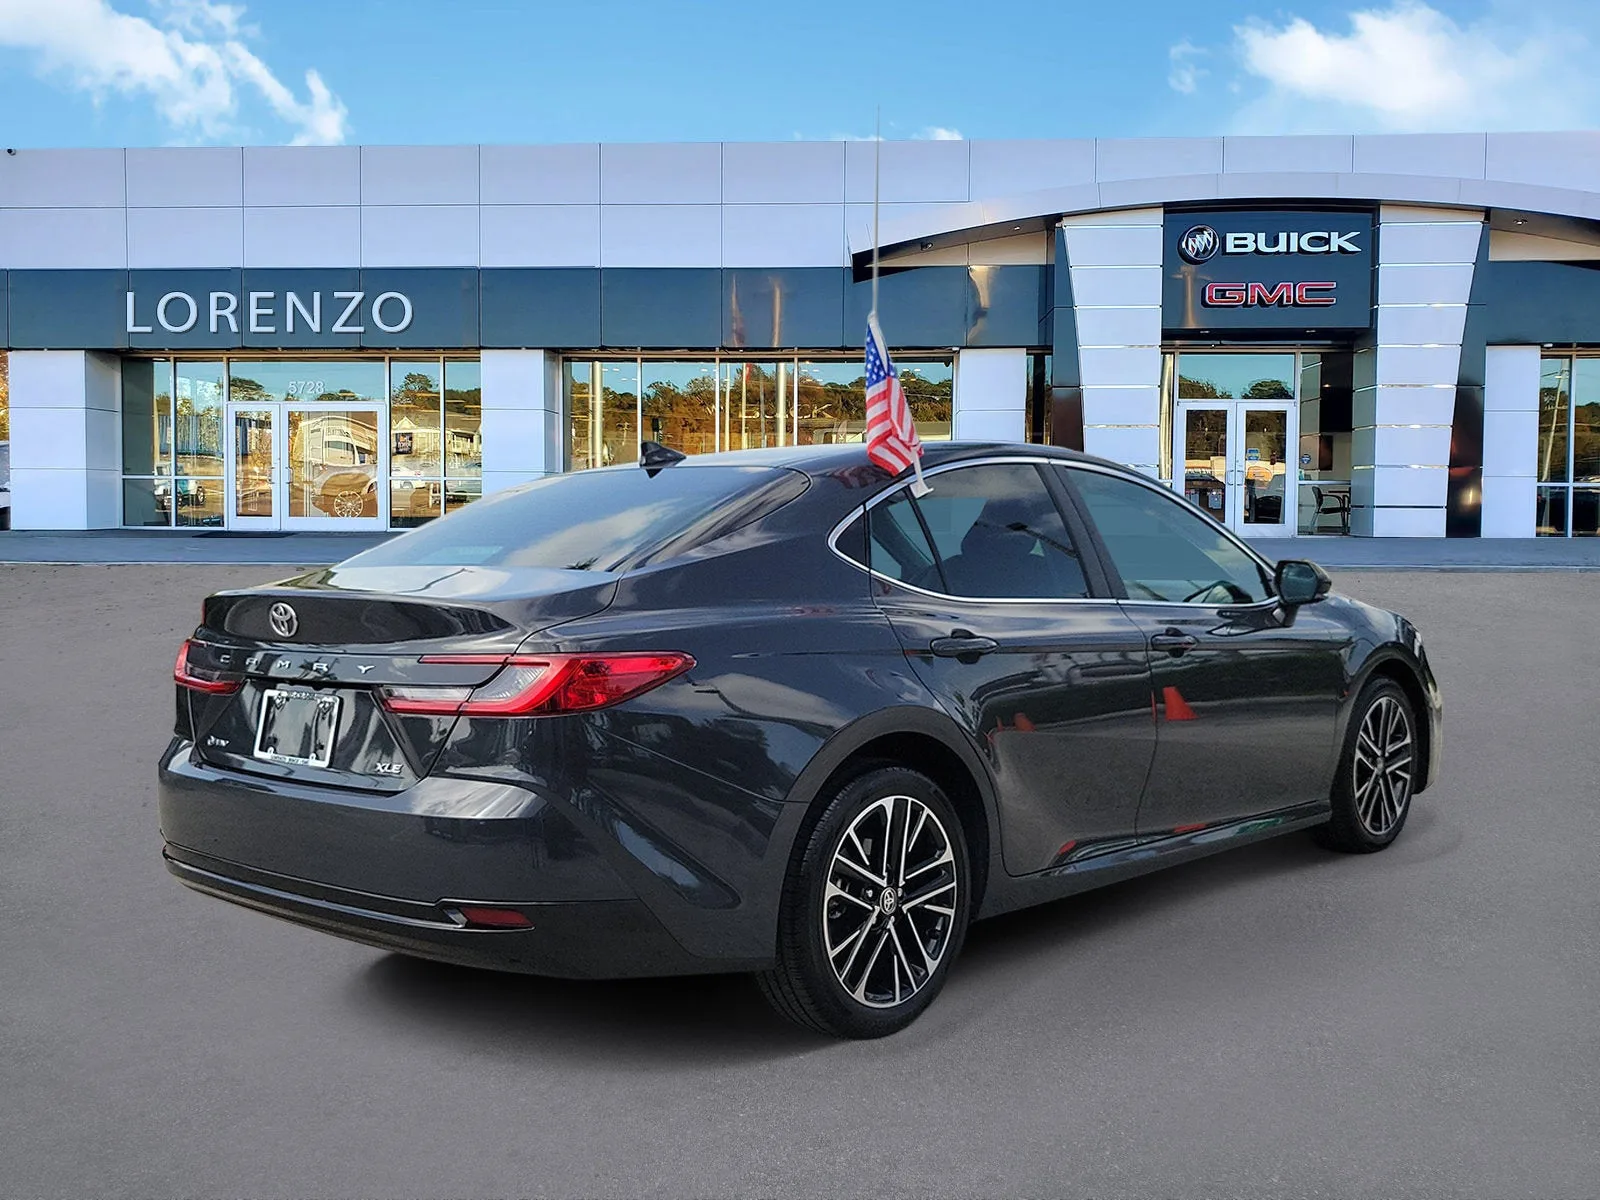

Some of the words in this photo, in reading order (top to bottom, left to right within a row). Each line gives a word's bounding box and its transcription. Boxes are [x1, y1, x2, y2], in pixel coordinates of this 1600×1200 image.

[1225, 231, 1362, 253] BUICK
[1205, 281, 1337, 305] GMC
[125, 290, 414, 334] LORENZO
[288, 380, 326, 395] 5728
[219, 654, 375, 674] CAMRY
[375, 762, 403, 774] XLE
